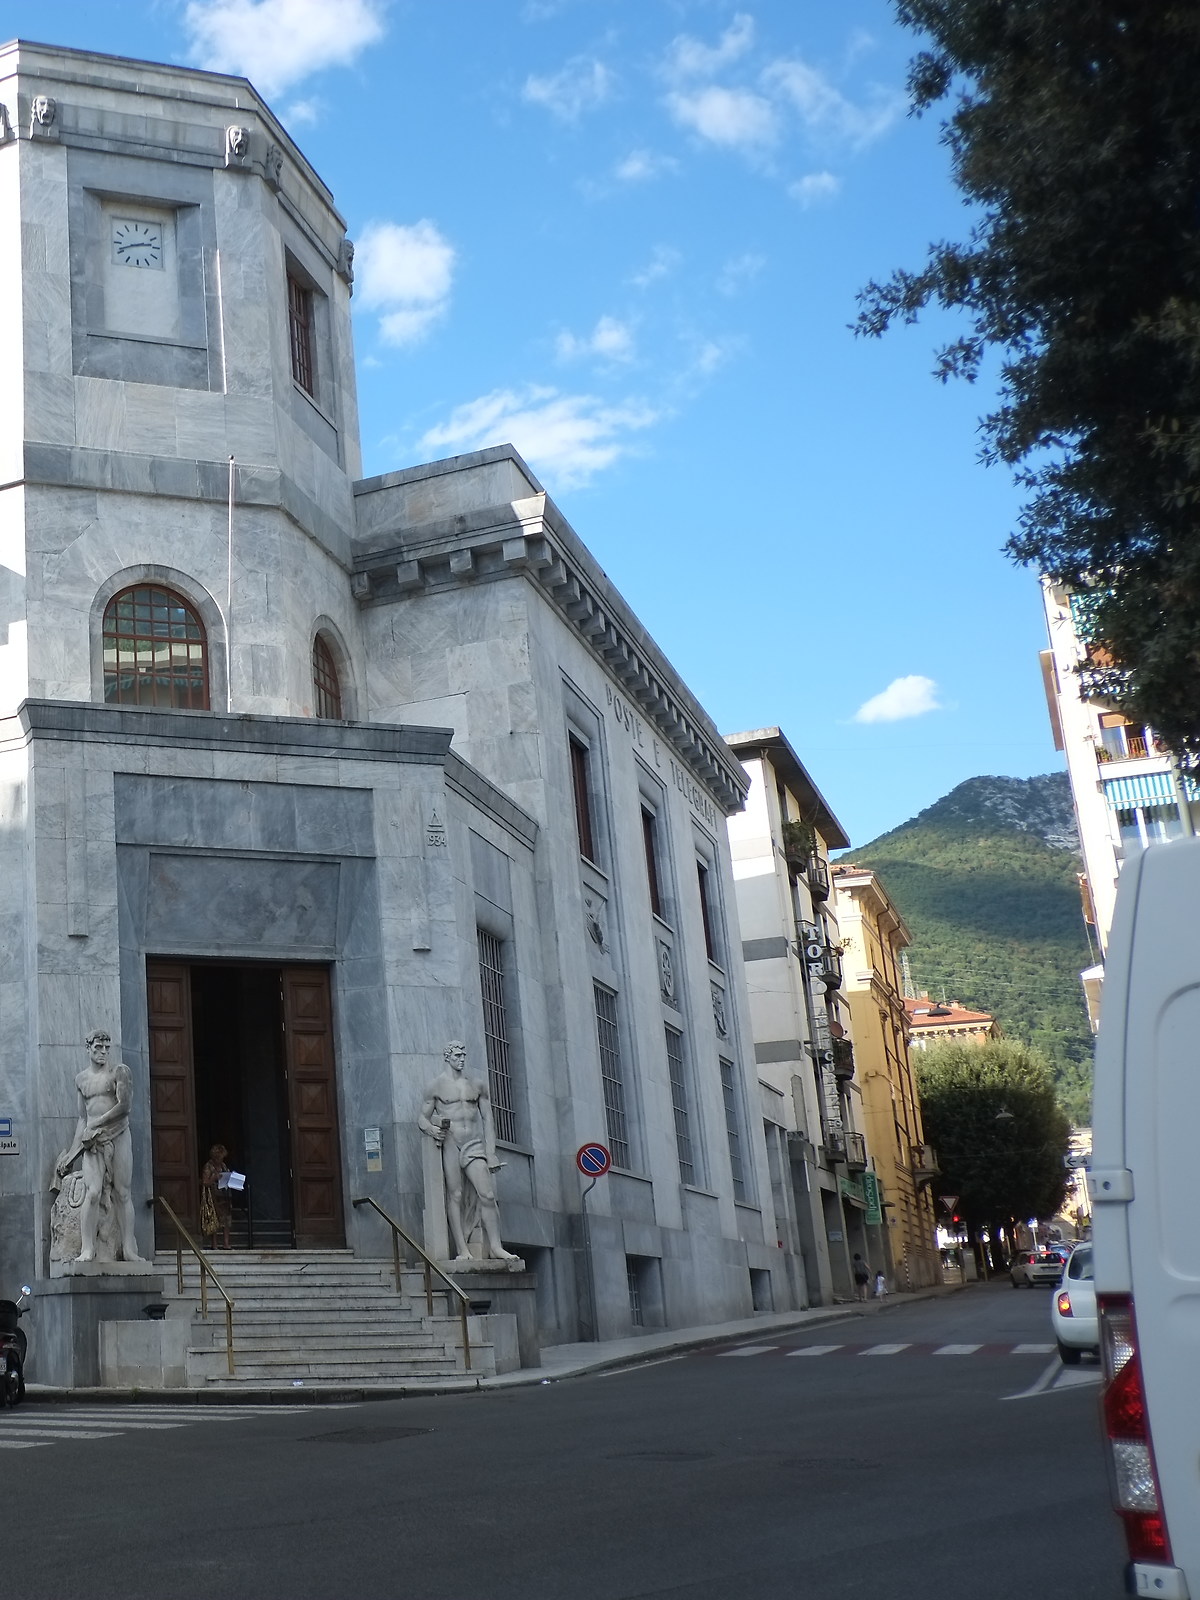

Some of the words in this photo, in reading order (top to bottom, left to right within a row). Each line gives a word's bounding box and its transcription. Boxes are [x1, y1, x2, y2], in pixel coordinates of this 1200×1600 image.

[605, 683, 644, 748] POSTE
[653, 738, 661, 768] E
[805, 926, 828, 996] TORO
